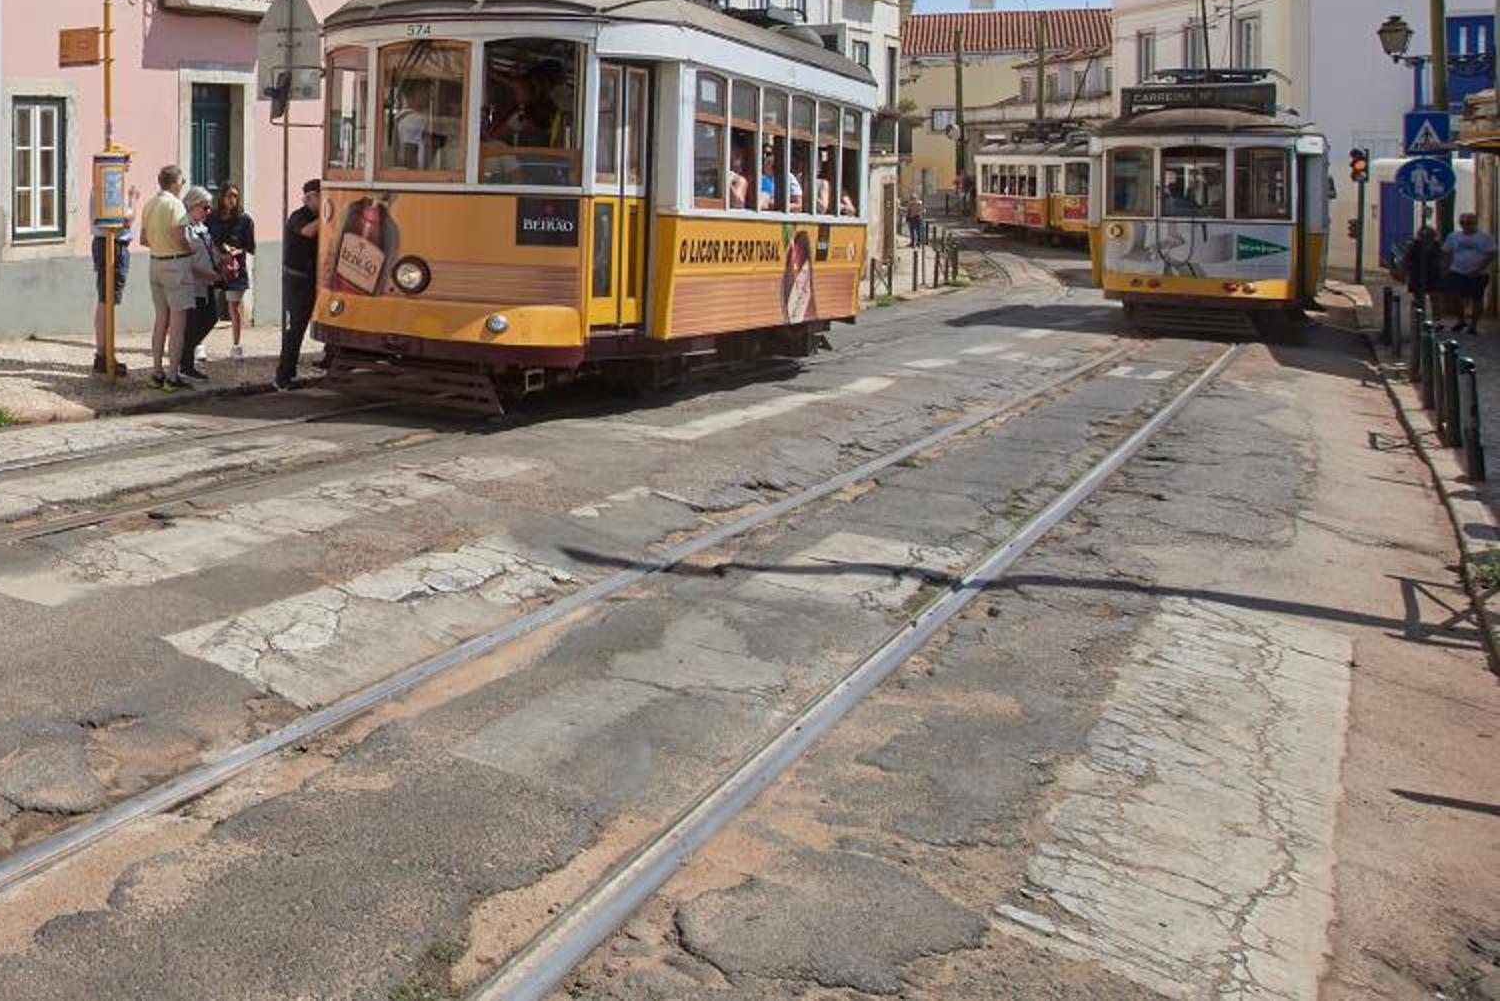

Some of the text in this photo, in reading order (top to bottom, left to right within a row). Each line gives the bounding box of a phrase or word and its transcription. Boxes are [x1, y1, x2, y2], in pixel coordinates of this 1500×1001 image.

[406, 24, 431, 36] 574
[680, 239, 780, 263] O LICOR DE PORTUGAL
